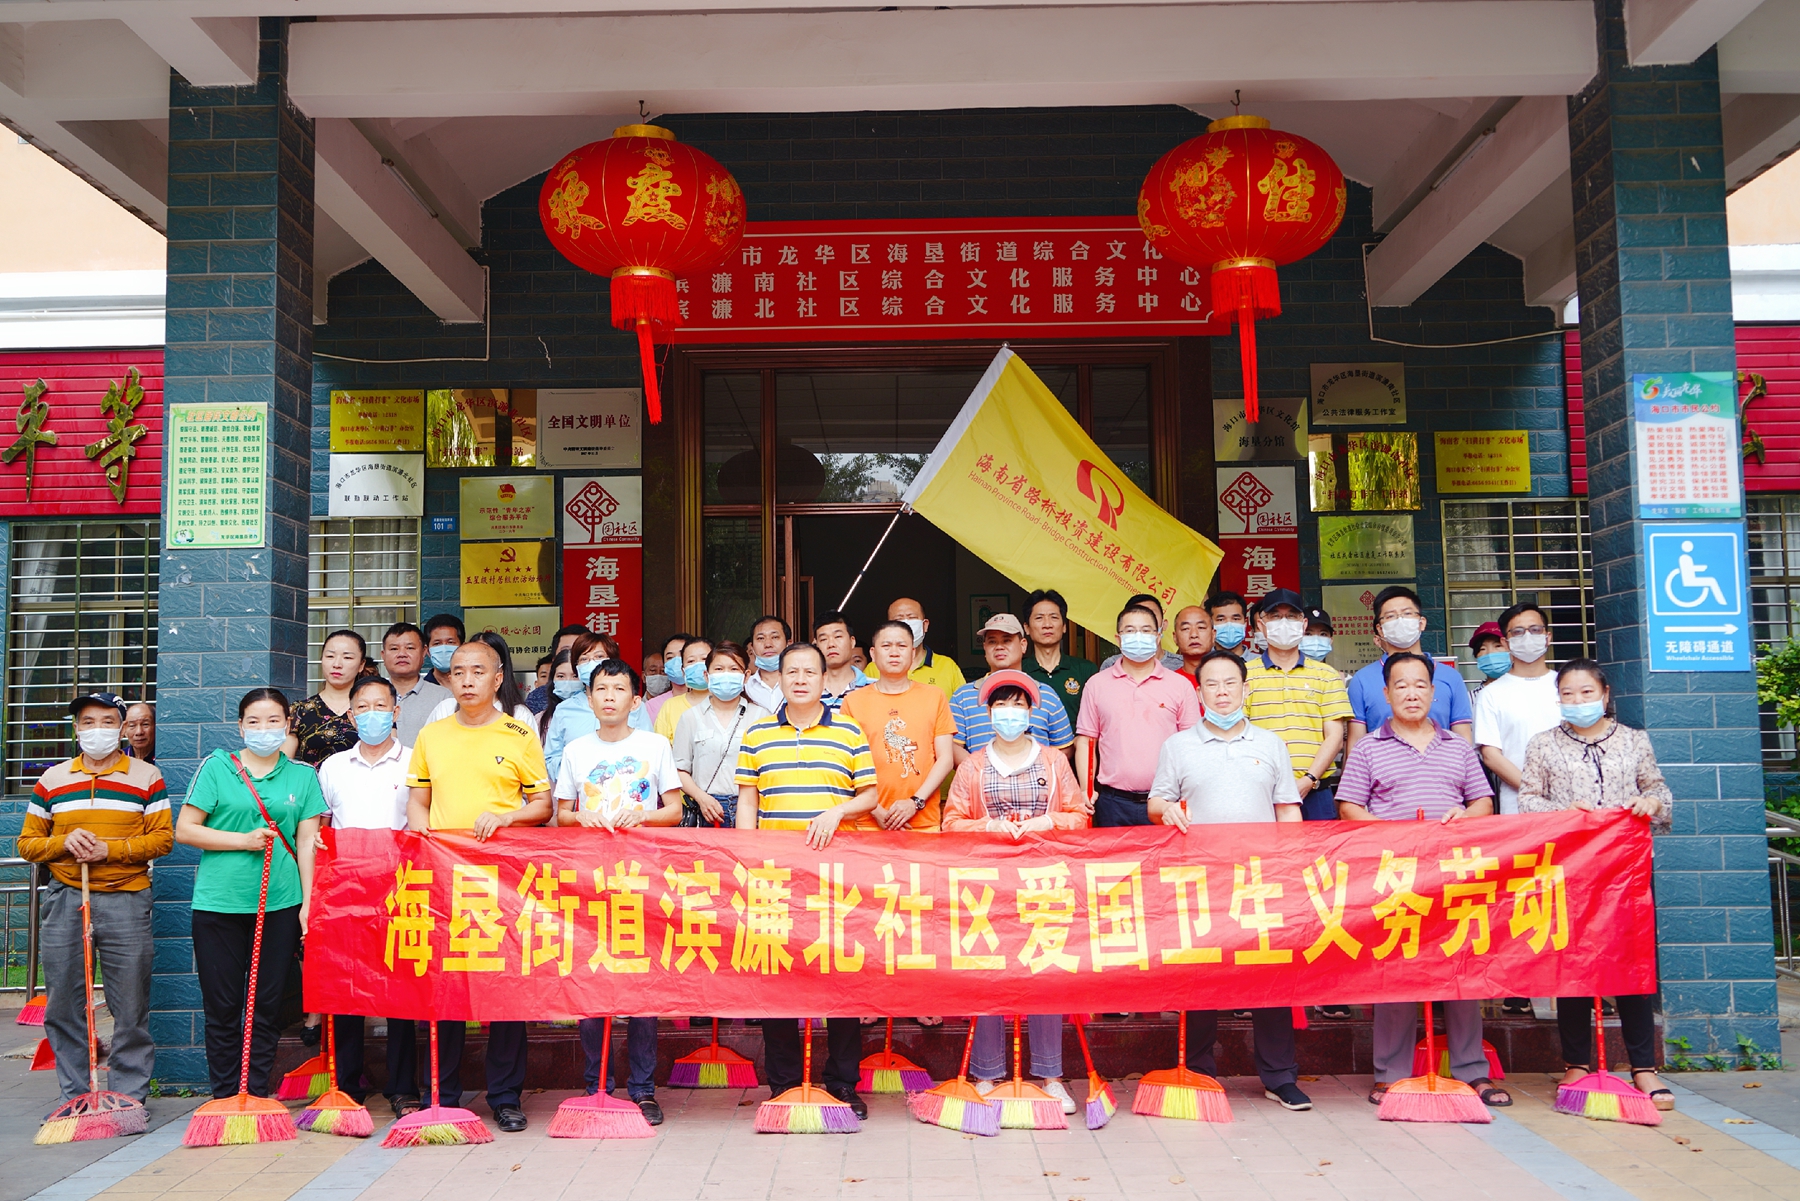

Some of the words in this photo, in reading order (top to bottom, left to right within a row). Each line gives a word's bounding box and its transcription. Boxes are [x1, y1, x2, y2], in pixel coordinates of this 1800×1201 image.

[622, 163, 688, 230] 度
[1257, 158, 1316, 224] 佳
[1222, 405, 1301, 433] 海口市华区文化馆
[1322, 408, 1396, 417] 公共法律服务工作室
[1651, 404, 1720, 414] 海口市市民公约
[547, 414, 631, 429] 全国文明单位
[1238, 435, 1285, 448] 海垦分馆
[967, 470, 993, 492] Hainan
[991, 487, 1022, 512] Province
[1064, 538, 1109, 573] Construction
[1107, 568, 1144, 596] Investmen
[975, 453, 1177, 606] 海南省路桥投资建设有限公司
[499, 625, 542, 636] 暖心家园
[1665, 640, 1735, 654] 无障碍通道
[384, 842, 1570, 976] 海垦街道滨濂北社区爱国卫生义务劳动
